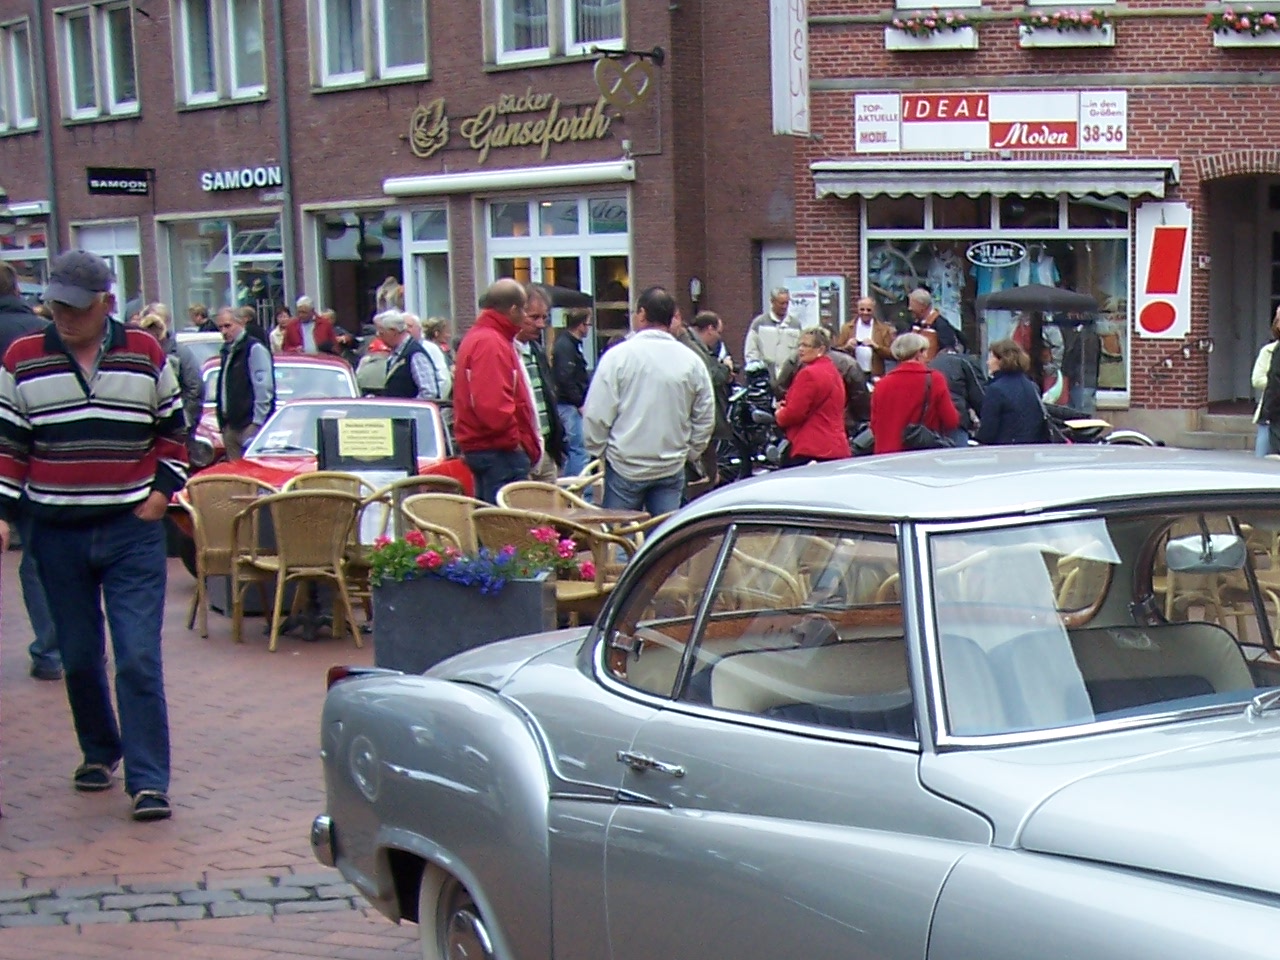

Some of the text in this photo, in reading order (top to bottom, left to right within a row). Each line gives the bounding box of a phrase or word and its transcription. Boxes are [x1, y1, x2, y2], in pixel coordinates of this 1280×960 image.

[903, 99, 987, 117] IDEAL
[460, 97, 610, 165] Ganseforth
[994, 122, 1069, 147] Moden
[1083, 124, 1123, 142] 38-56
[90, 180, 147, 188] SAMOON
[201, 166, 282, 192] SAMOON
